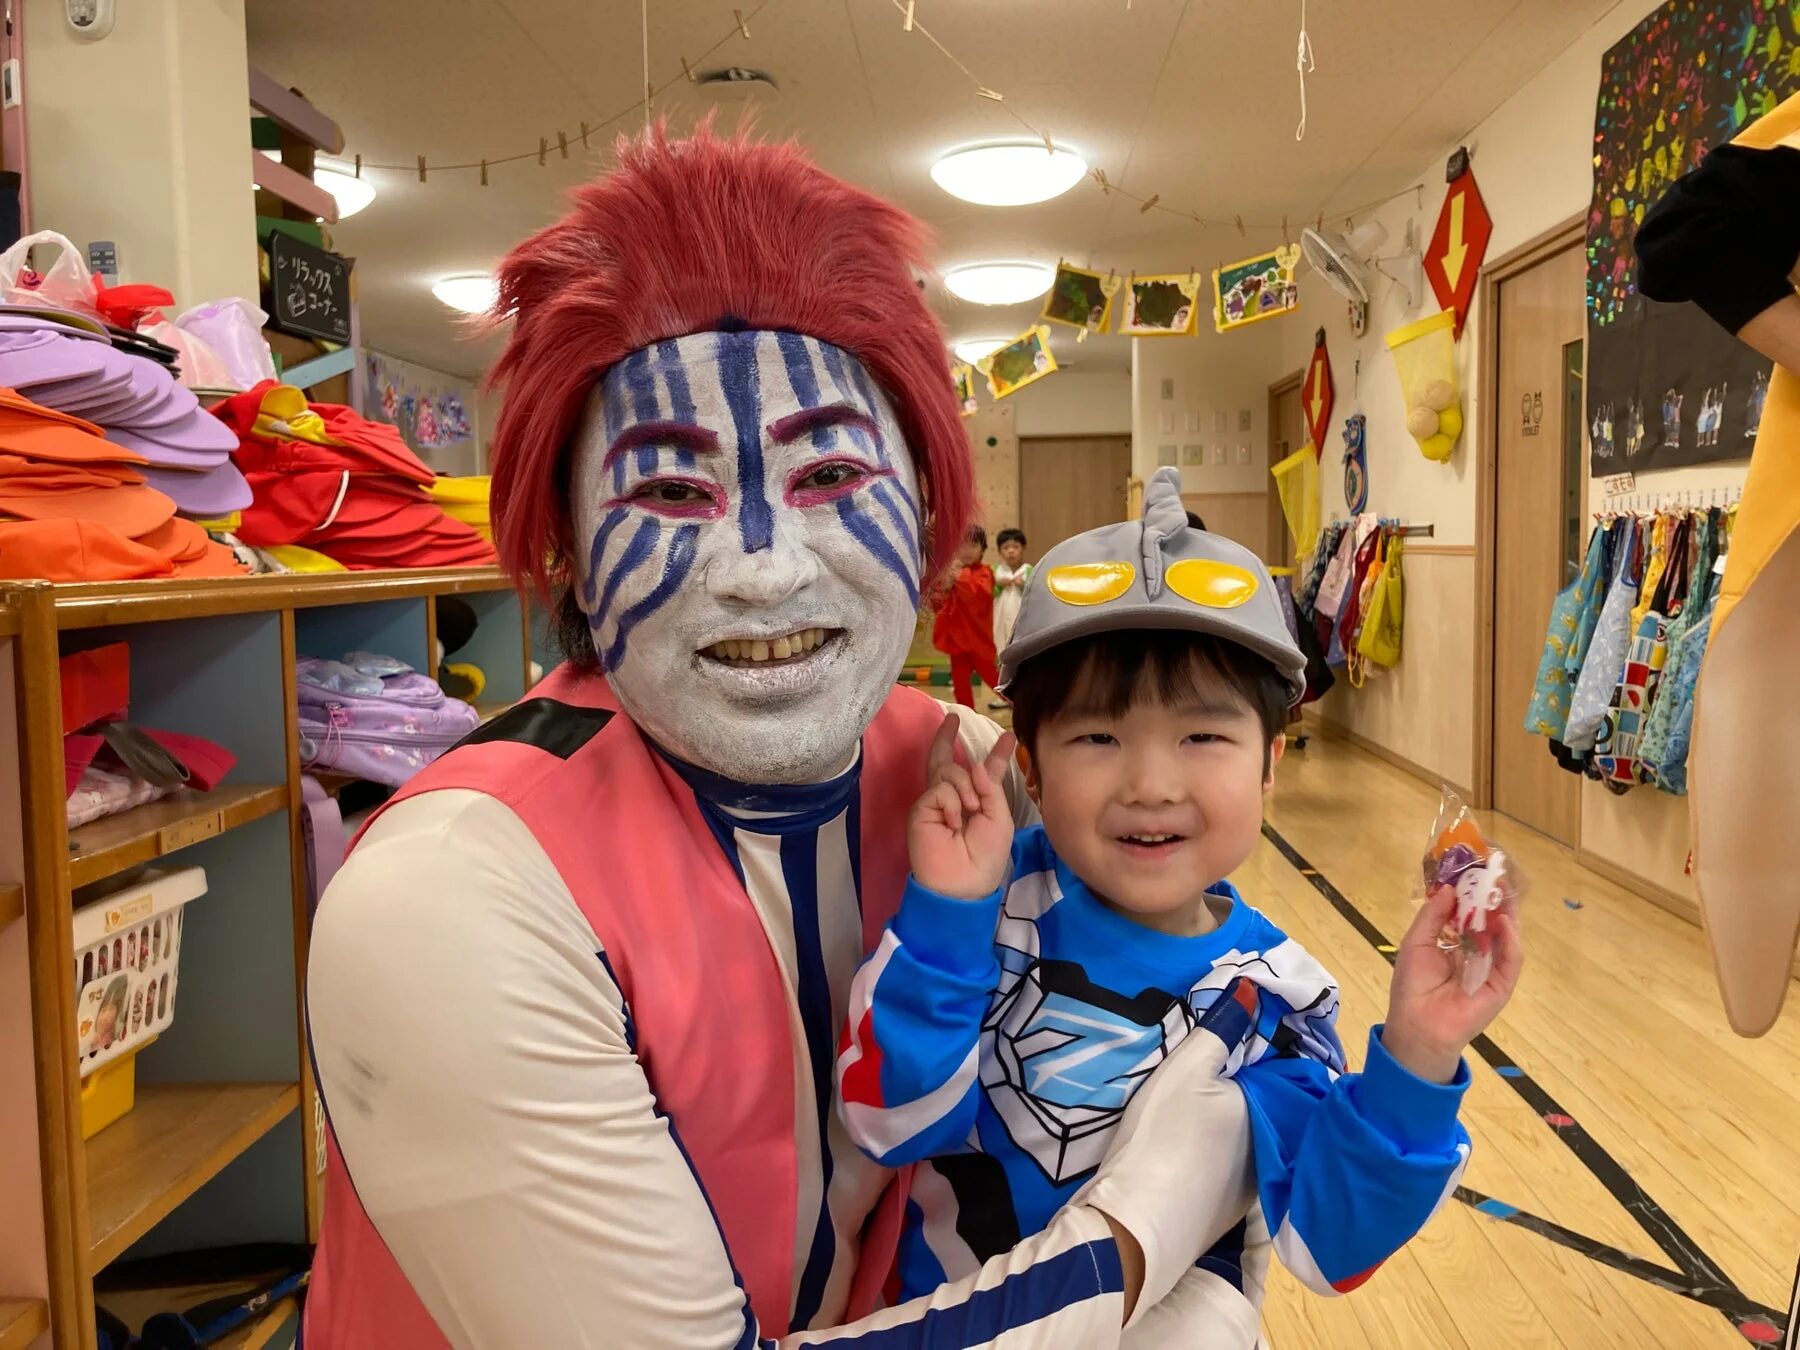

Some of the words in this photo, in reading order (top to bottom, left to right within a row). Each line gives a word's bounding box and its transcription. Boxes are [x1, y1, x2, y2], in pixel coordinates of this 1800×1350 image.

[292, 257, 333, 295] リラックス
[308, 292, 337, 316] コーナー
